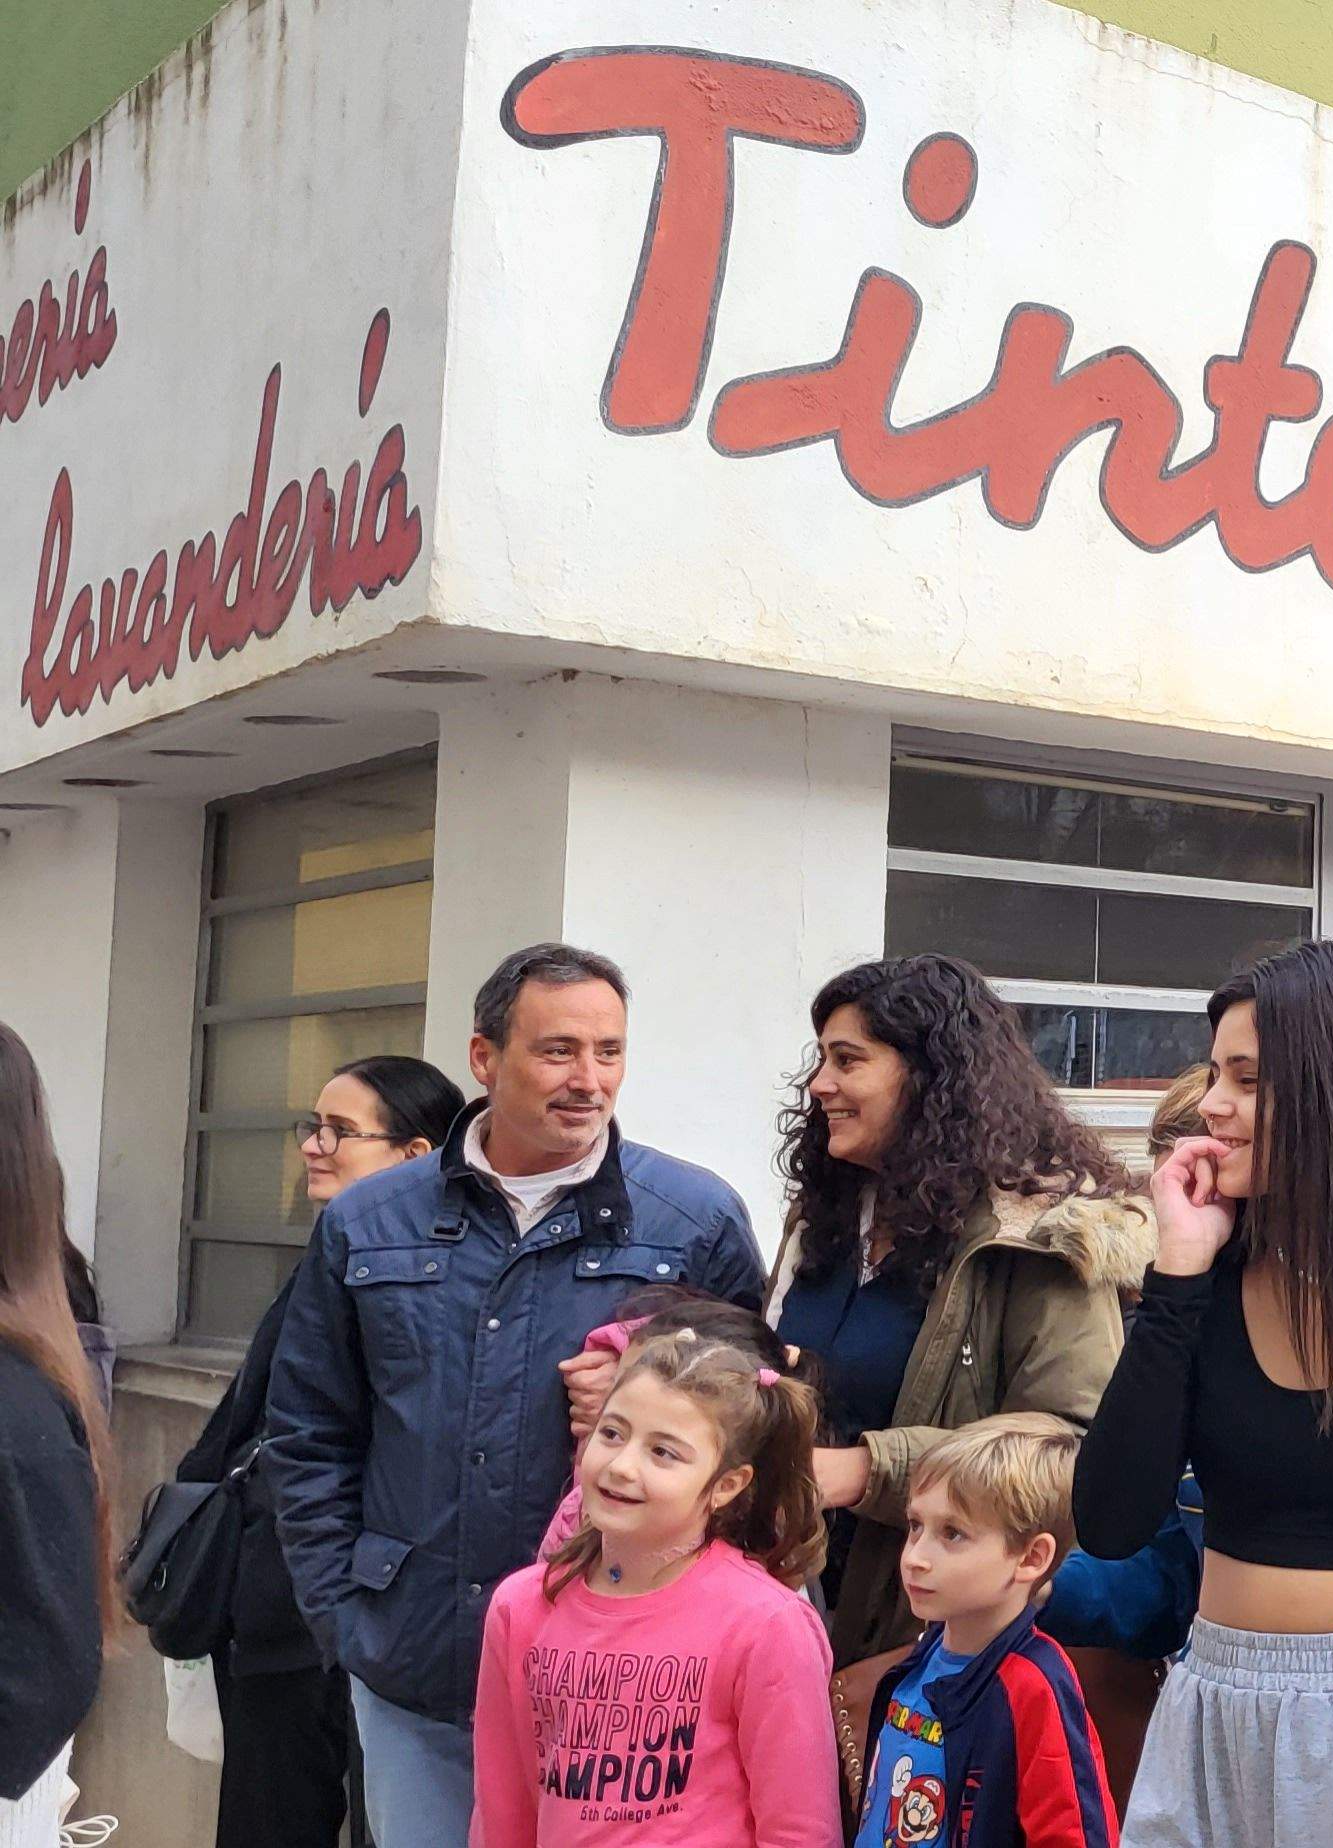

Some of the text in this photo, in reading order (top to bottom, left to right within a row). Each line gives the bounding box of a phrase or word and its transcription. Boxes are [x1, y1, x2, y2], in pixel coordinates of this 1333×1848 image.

[0, 158, 118, 423] ería
[21, 307, 422, 728] lavandería
[523, 1646, 708, 1703] CHAMPION
[905, 1710, 943, 1745] MAR
[604, 1806, 652, 1824] College
